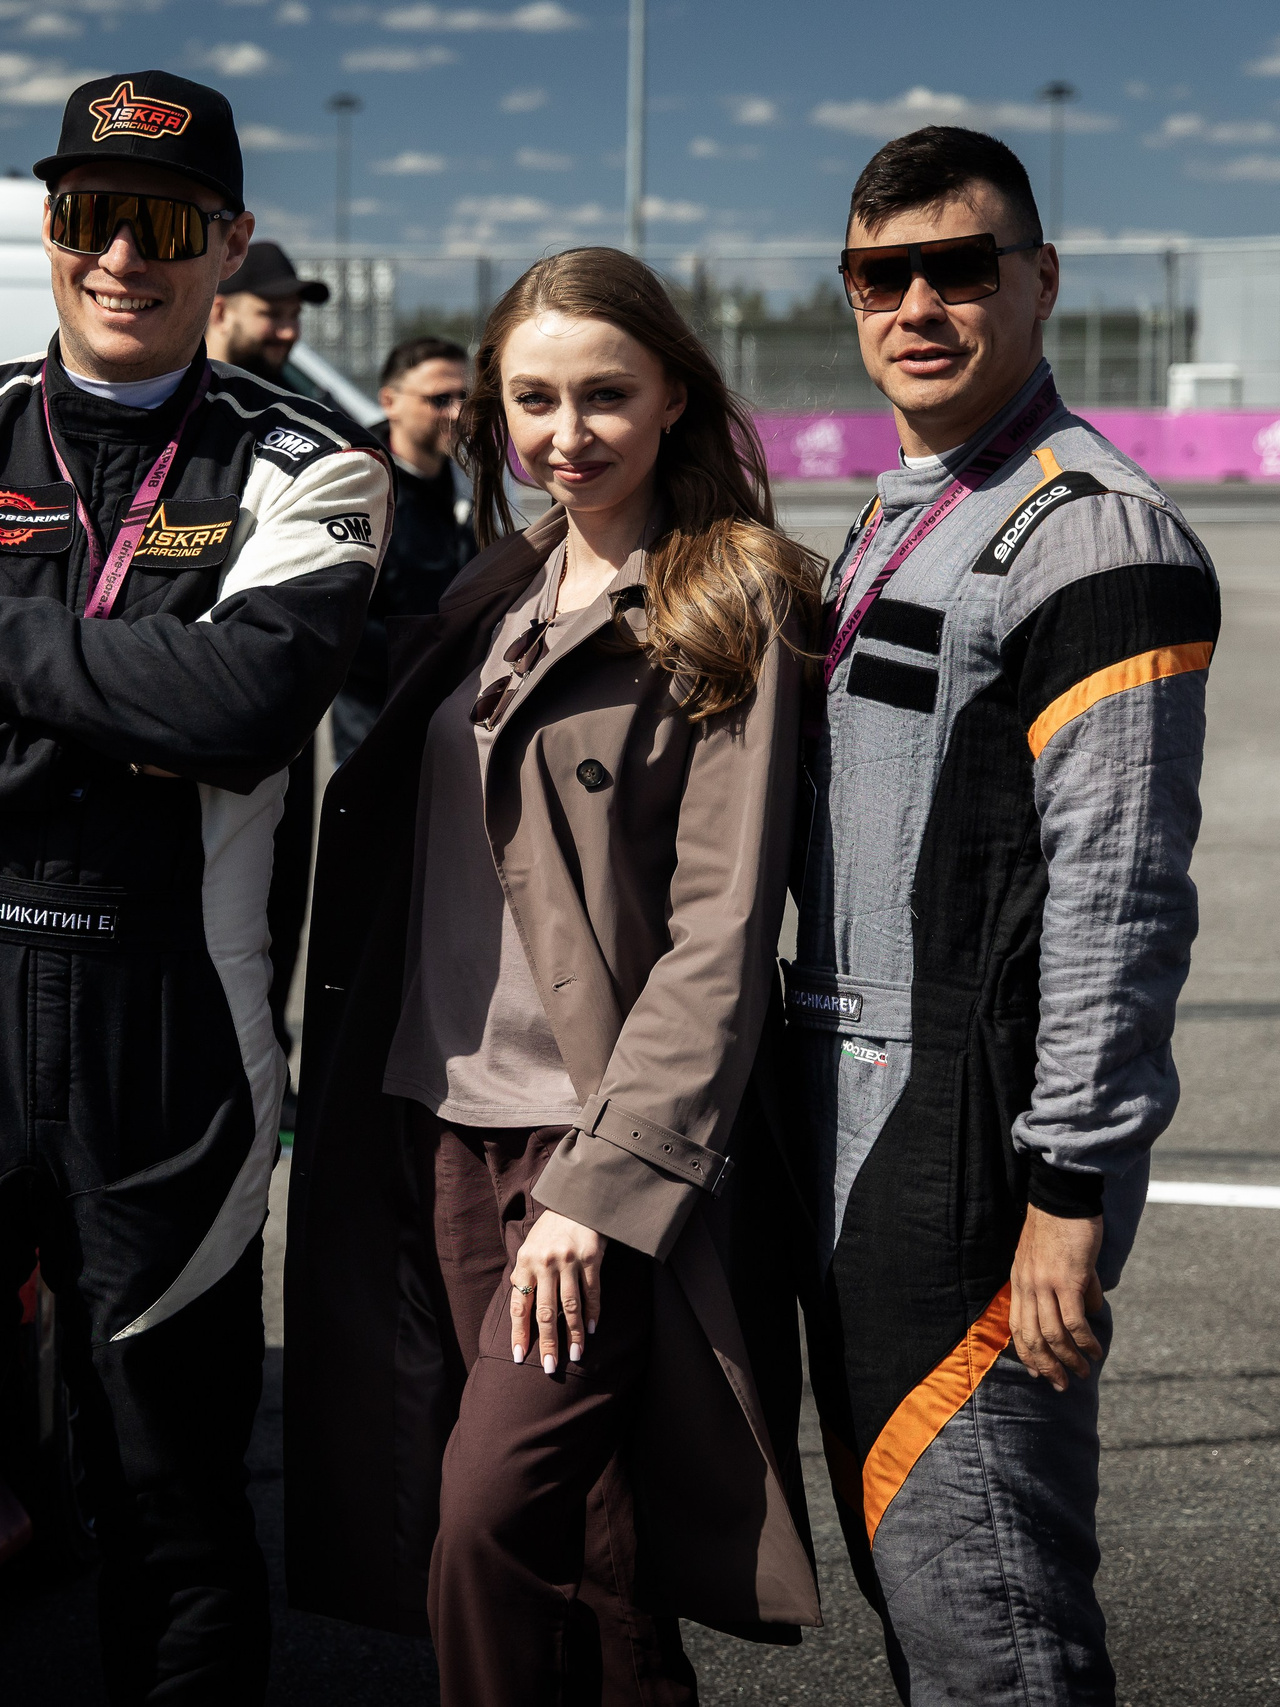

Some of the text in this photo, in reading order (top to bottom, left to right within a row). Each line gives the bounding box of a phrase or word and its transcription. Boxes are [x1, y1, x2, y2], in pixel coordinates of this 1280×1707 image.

[111, 108, 181, 129] ISKRA
[113, 121, 159, 133] RACING
[265, 430, 314, 456] OMP
[326, 517, 372, 543] OMP
[899, 485, 965, 556] drive-igora.ru
[994, 486, 1069, 562] sparco
[146, 527, 228, 548] ISKRA
[147, 547, 203, 558] RACING
[93, 539, 133, 619] drive-igora.ru
[97, 915, 114, 931] Е.
